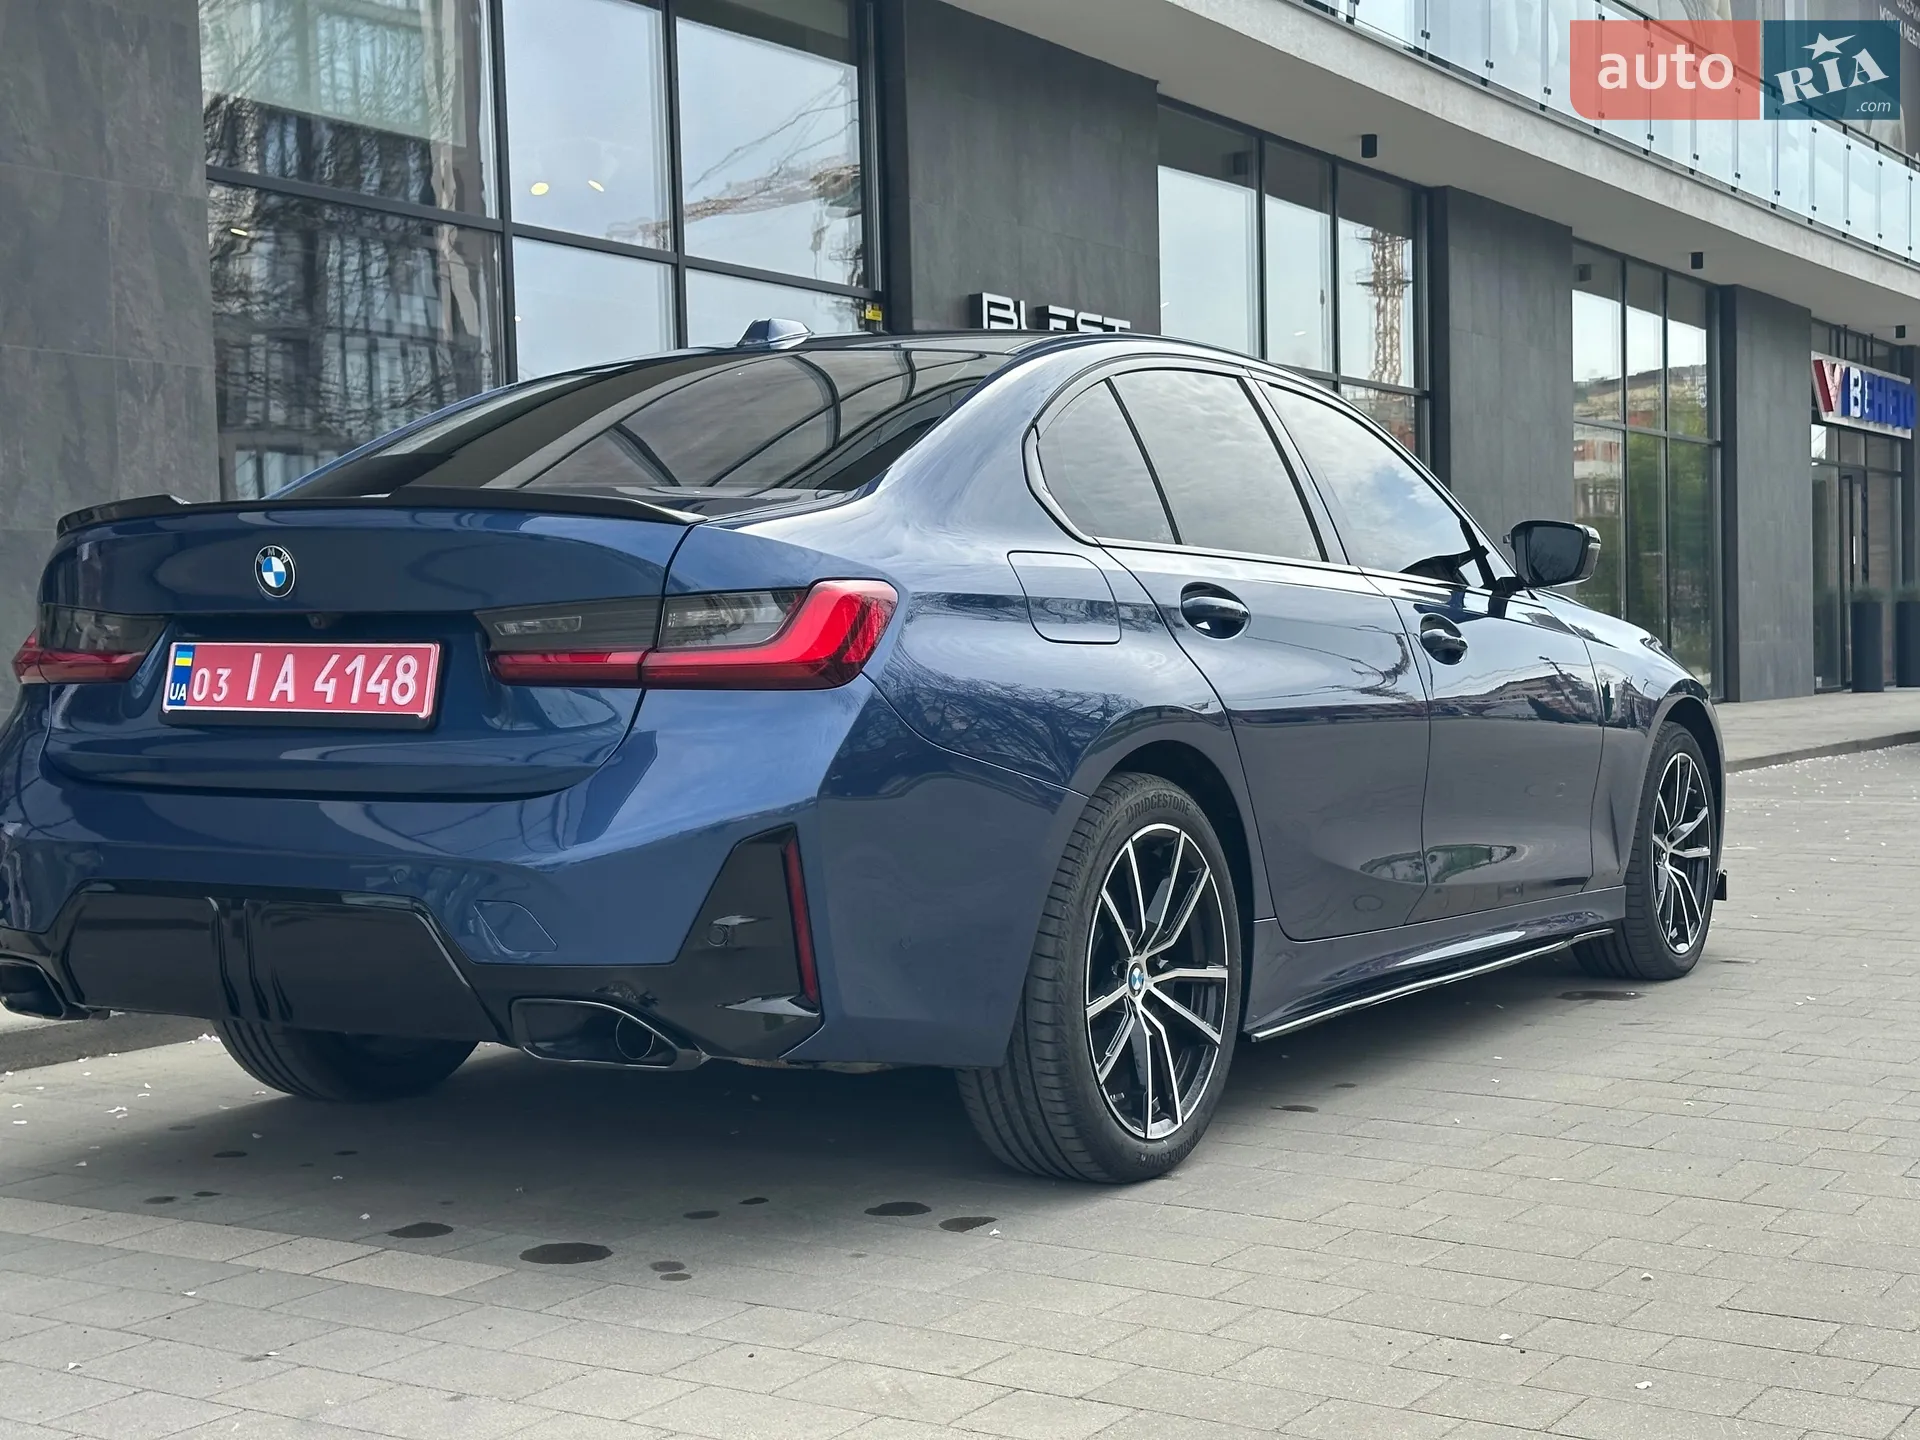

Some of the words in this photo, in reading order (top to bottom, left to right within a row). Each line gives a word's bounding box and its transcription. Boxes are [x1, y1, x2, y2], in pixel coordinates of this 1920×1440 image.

[257, 547, 289, 564] BMW
[169, 682, 186, 700] UA
[192, 668, 232, 702] 03
[313, 654, 418, 706] 4148
[1124, 793, 1191, 821] BRIDGESTONE
